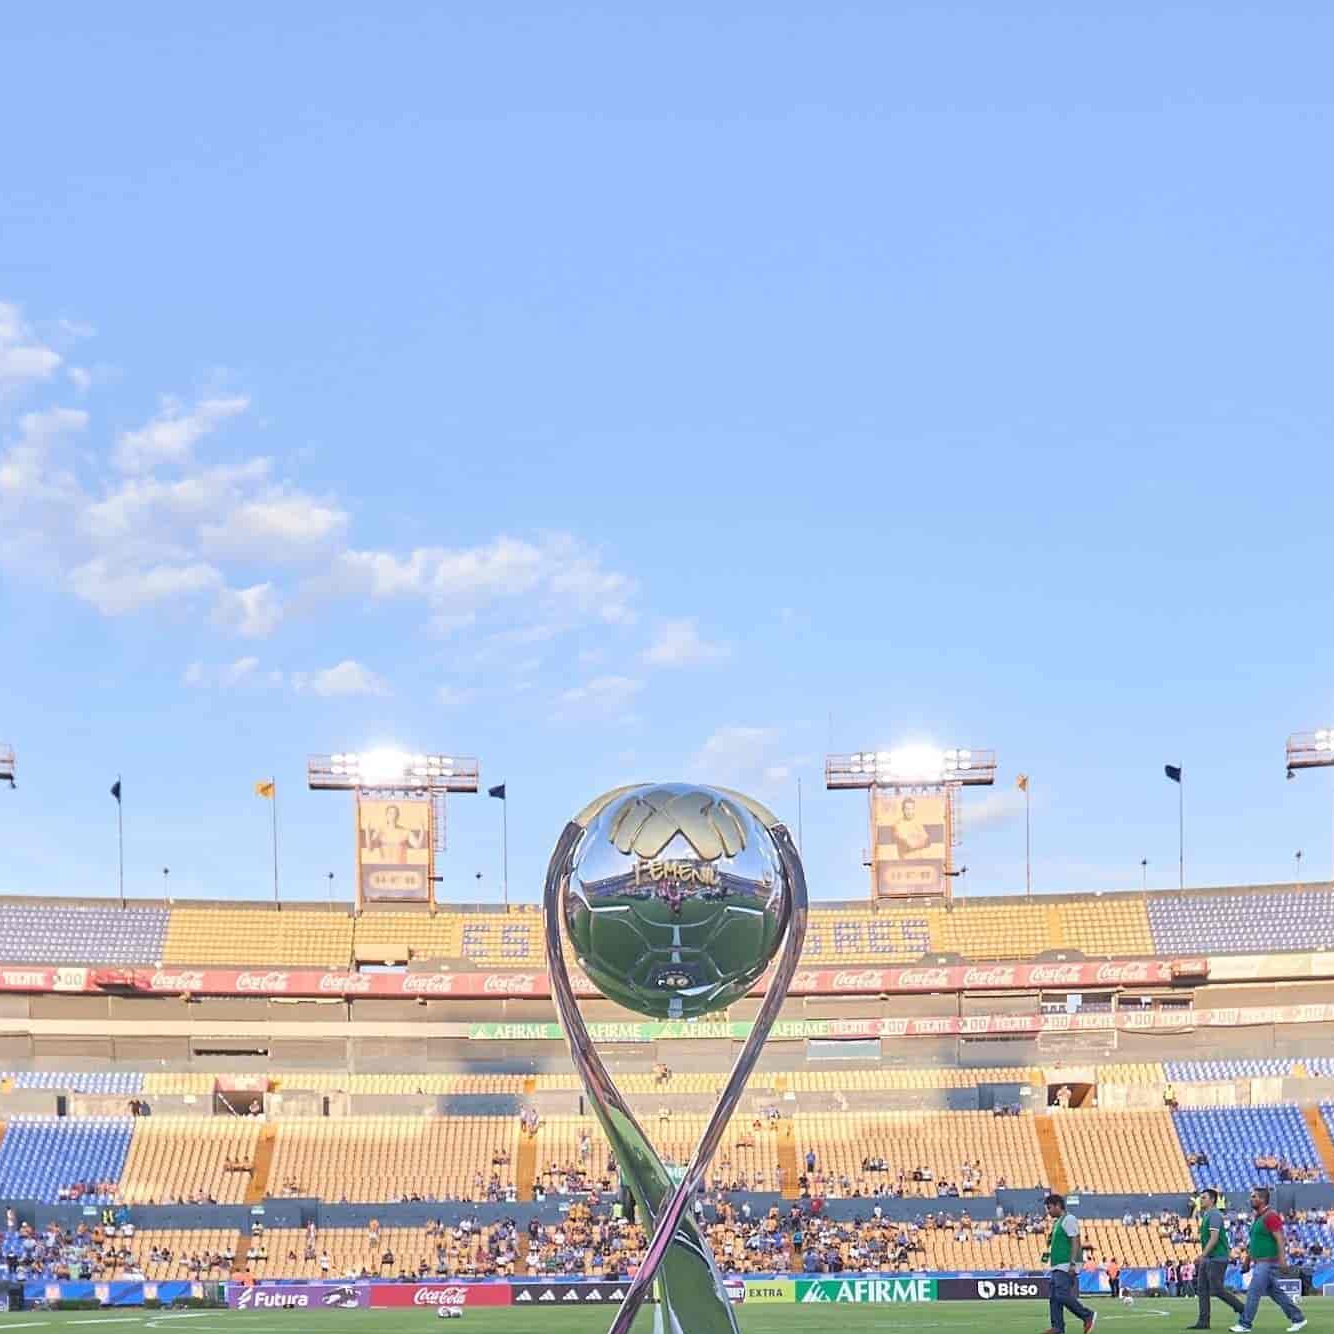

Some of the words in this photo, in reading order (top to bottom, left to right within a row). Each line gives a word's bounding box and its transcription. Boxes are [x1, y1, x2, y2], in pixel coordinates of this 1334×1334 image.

[413, 1286, 467, 1304] Coca-Cola
[749, 1288, 783, 1297] EXTRA
[837, 1279, 931, 1303] AFIRME
[998, 1282, 1039, 1297] Bitso
[254, 1291, 309, 1308] Futura
